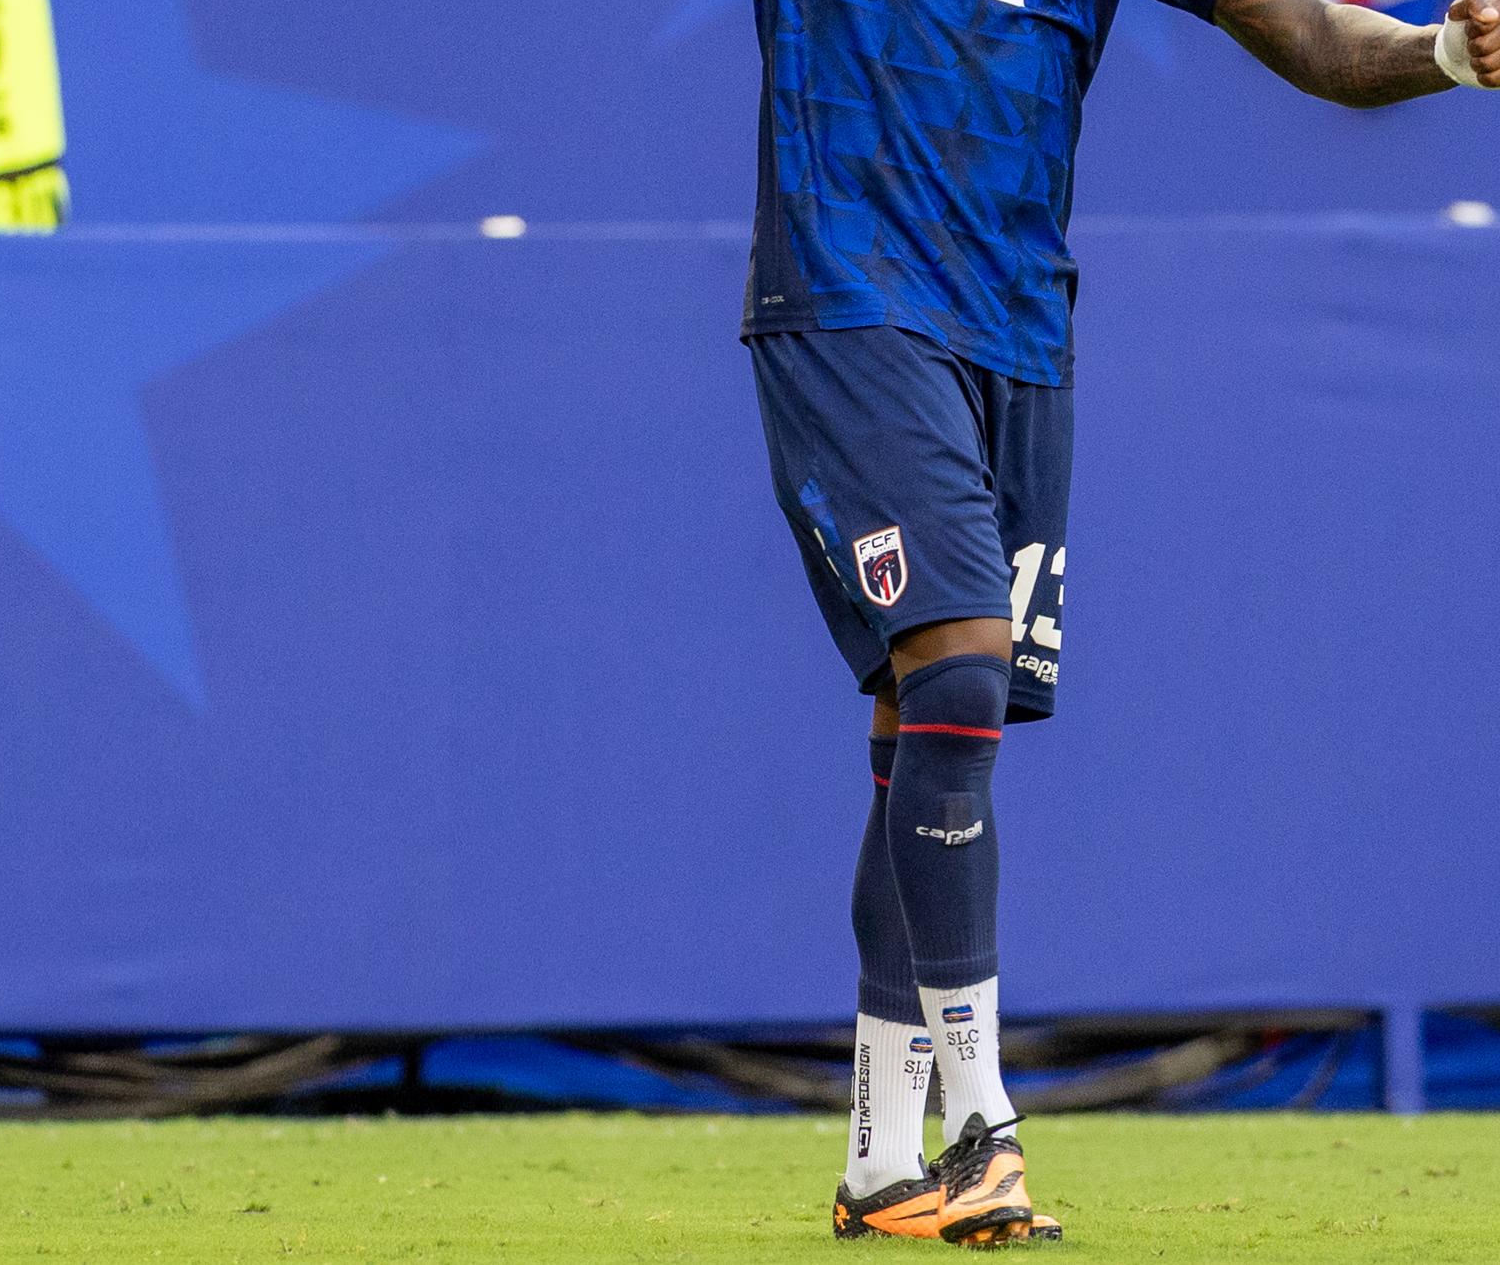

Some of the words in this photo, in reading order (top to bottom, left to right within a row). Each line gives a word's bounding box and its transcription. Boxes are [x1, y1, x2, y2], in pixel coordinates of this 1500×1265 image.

[859, 532, 896, 555] FCF
[946, 1029, 979, 1045] SLC
[957, 1046, 976, 1061] 13
[904, 1059, 932, 1075] SLC
[859, 1043, 871, 1126] TAPEDESIGN
[912, 1076, 925, 1091] 13
